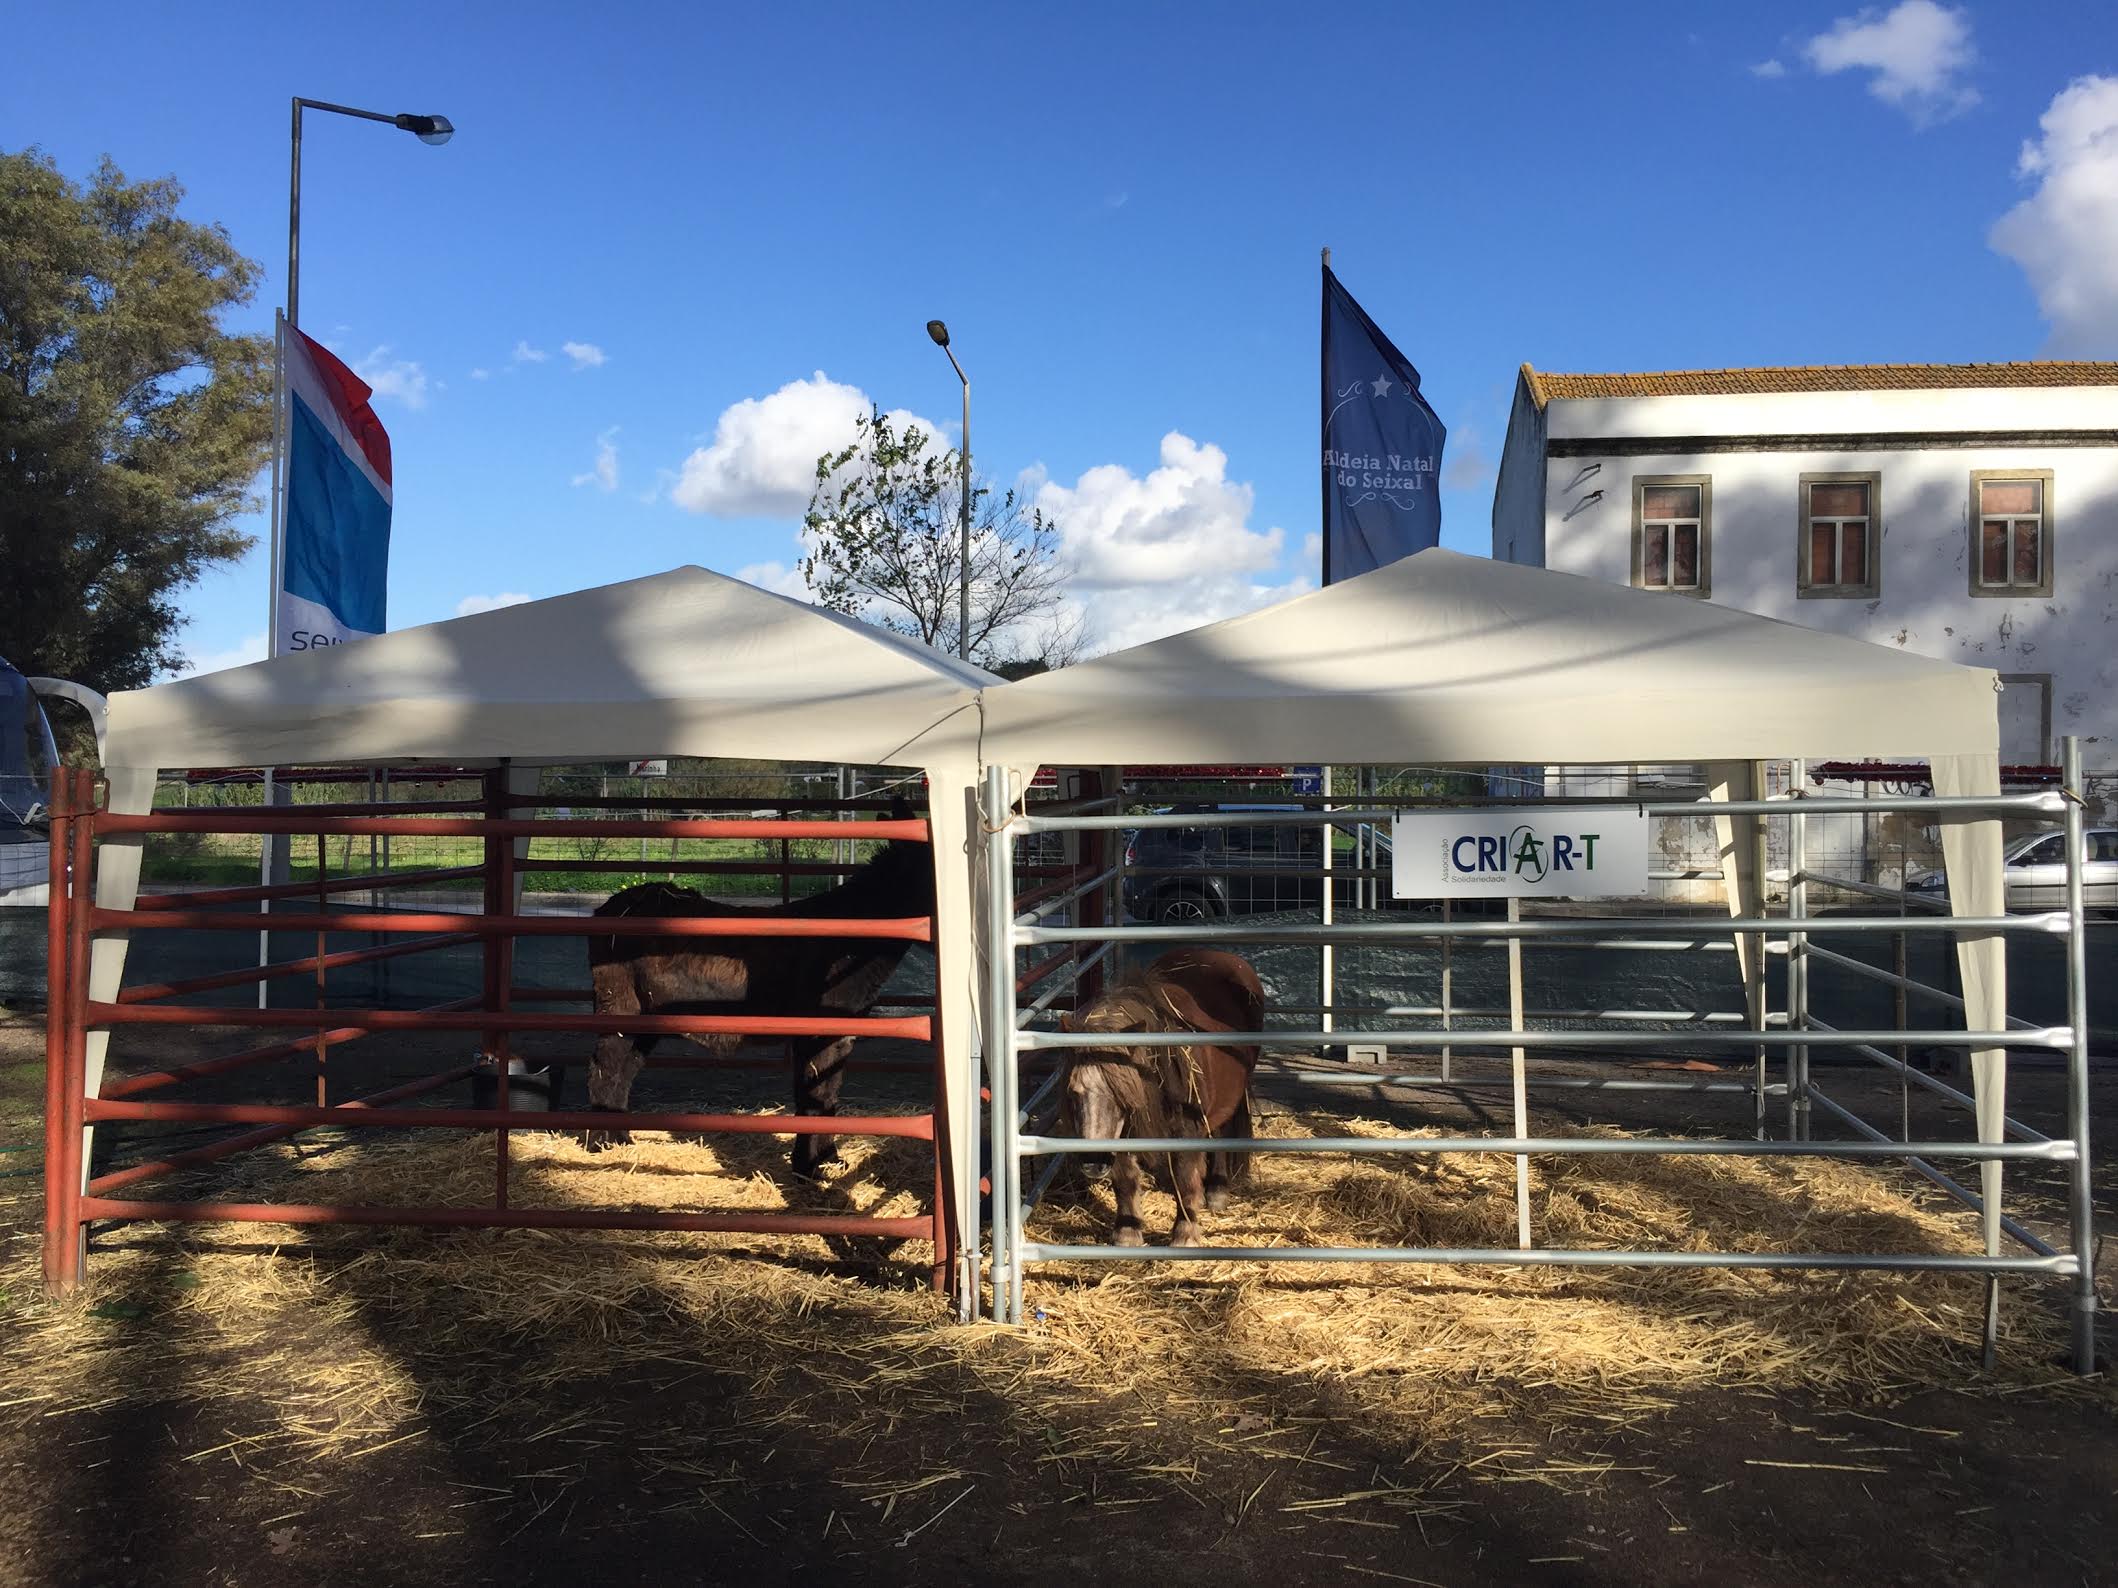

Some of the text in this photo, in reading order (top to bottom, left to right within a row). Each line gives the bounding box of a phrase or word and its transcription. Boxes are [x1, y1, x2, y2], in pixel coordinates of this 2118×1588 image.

[1323, 449, 1433, 472] Aldeia Natal
[1337, 470, 1423, 490] do Seixal
[1302, 778, 1312, 791] P
[1441, 838, 1450, 883] Associação
[1451, 875, 1506, 883] Solidariedade
